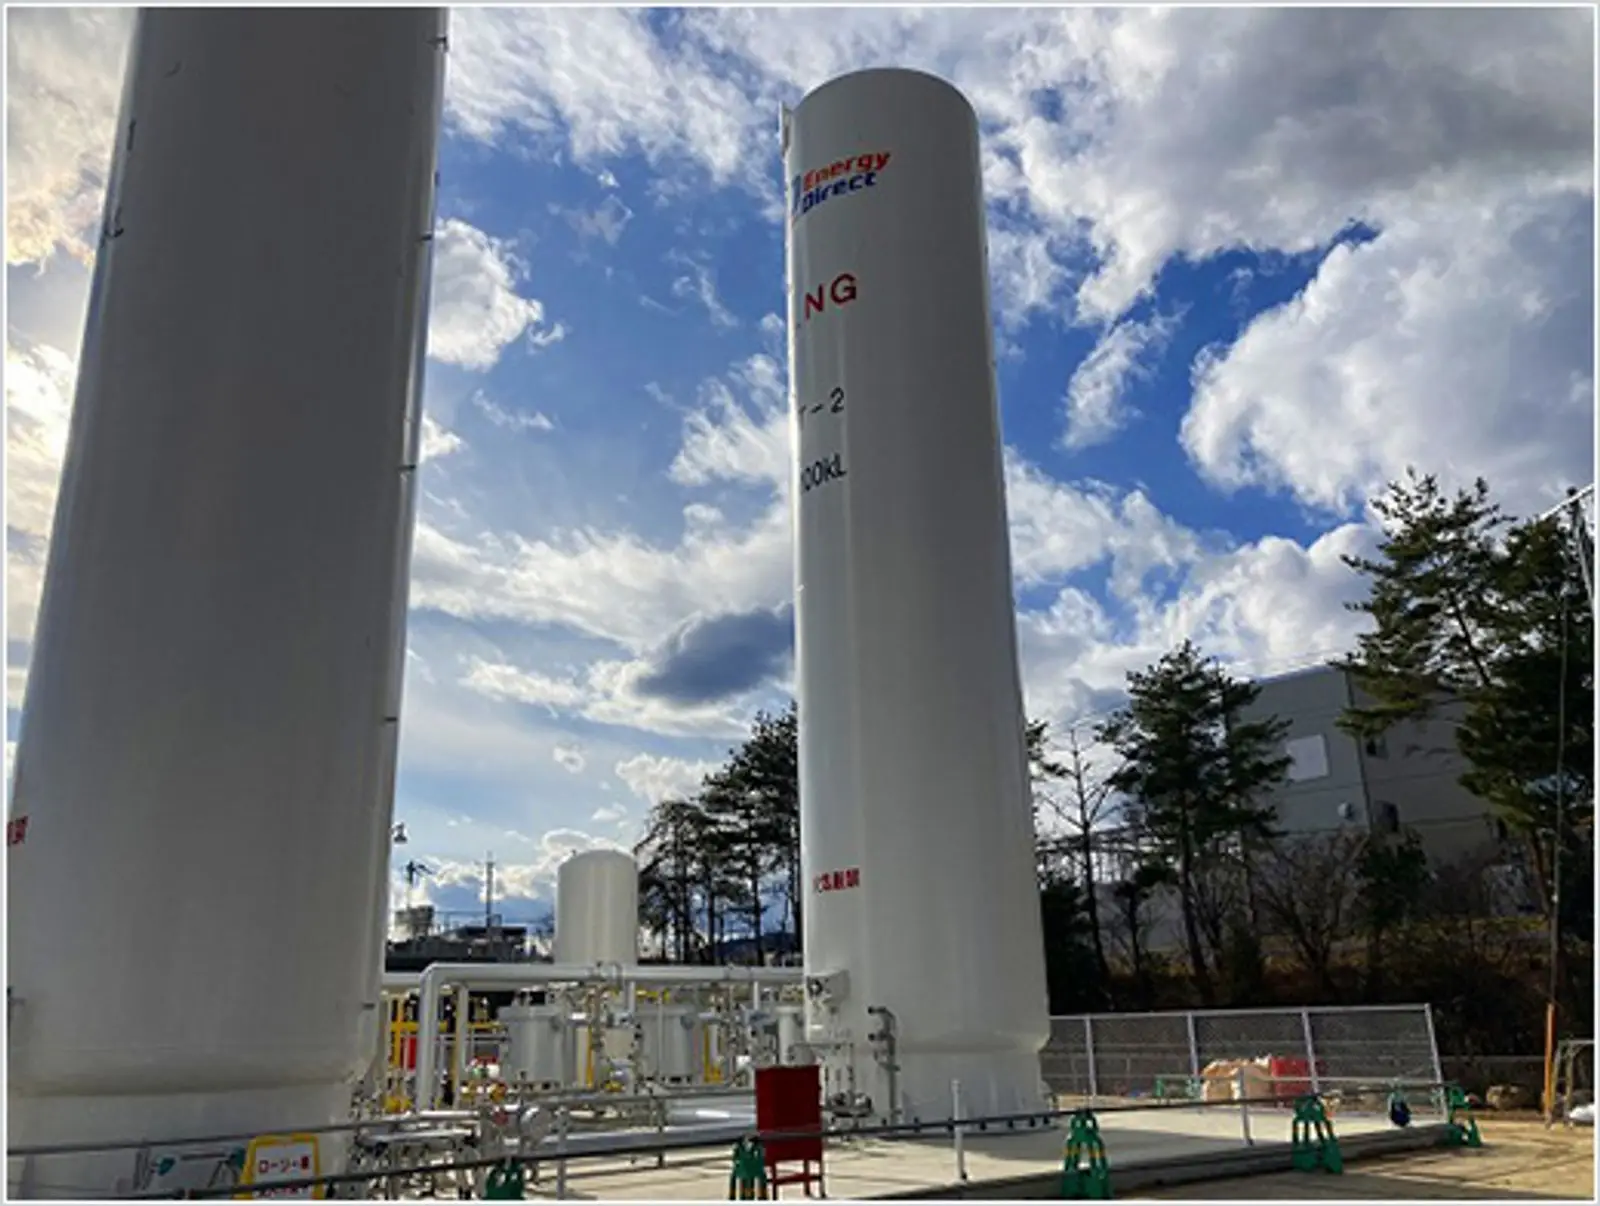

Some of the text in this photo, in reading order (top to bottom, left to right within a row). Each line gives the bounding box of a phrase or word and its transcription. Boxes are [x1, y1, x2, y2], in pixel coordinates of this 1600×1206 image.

[801, 171, 877, 214] Direct
[803, 151, 891, 192] Energy
[797, 273, 857, 329] NG
